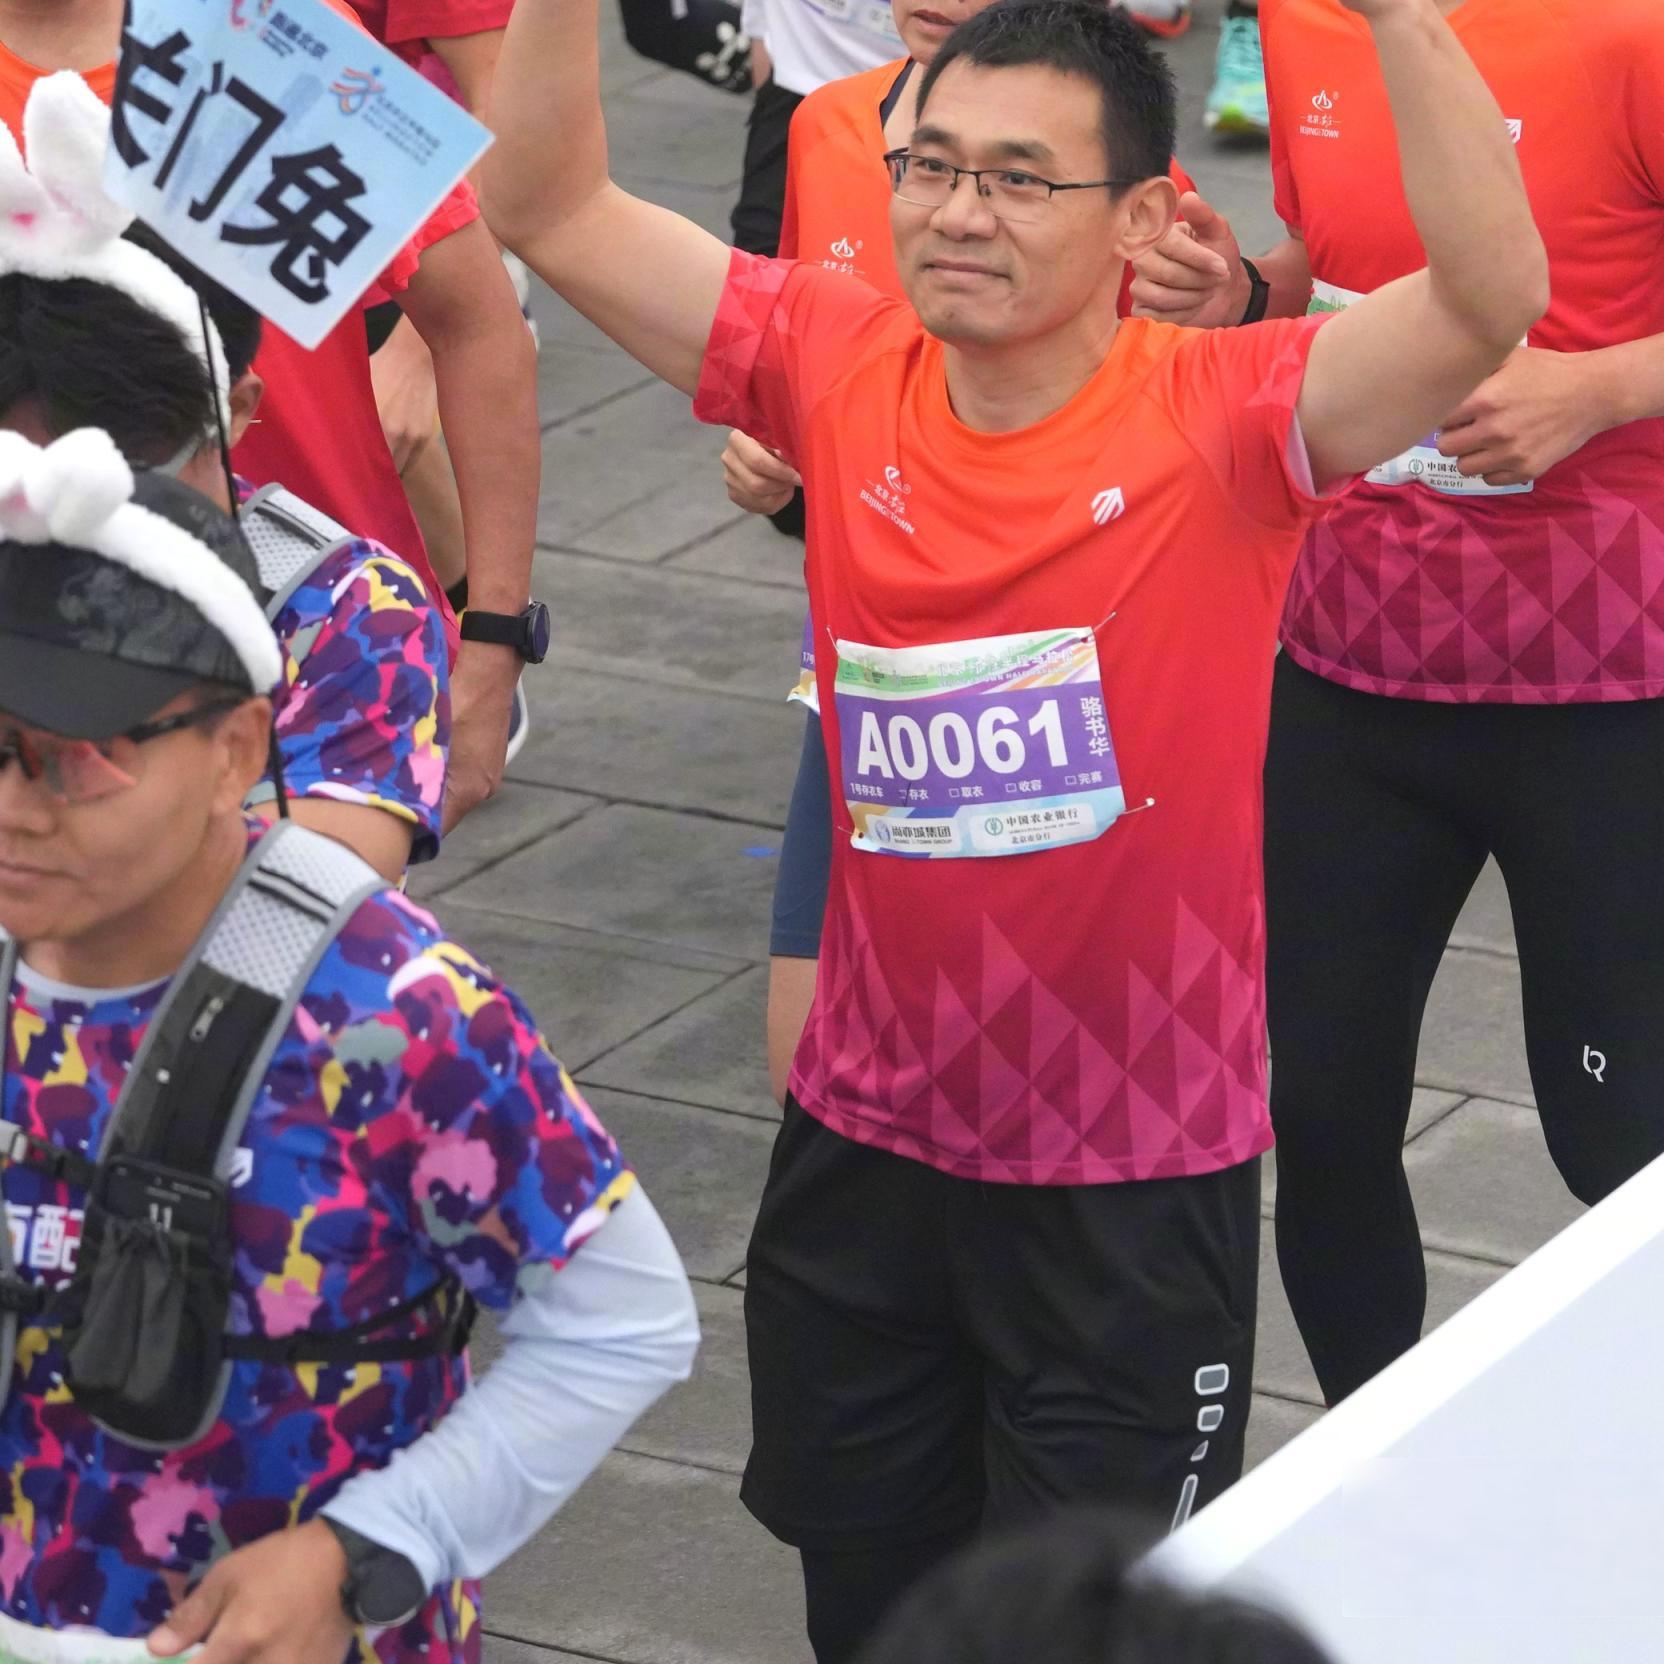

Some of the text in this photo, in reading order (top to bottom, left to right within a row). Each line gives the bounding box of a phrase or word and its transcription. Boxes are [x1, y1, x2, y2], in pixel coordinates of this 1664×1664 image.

[856, 698, 1070, 782] A0061
[1081, 697, 1112, 758] 骆书华
[909, 788, 929, 801] 存衣
[961, 786, 985, 798] 取衣
[1018, 779, 1043, 792] 收容
[1078, 771, 1103, 785] 完赛
[1006, 809, 1078, 827] 中国农业银行
